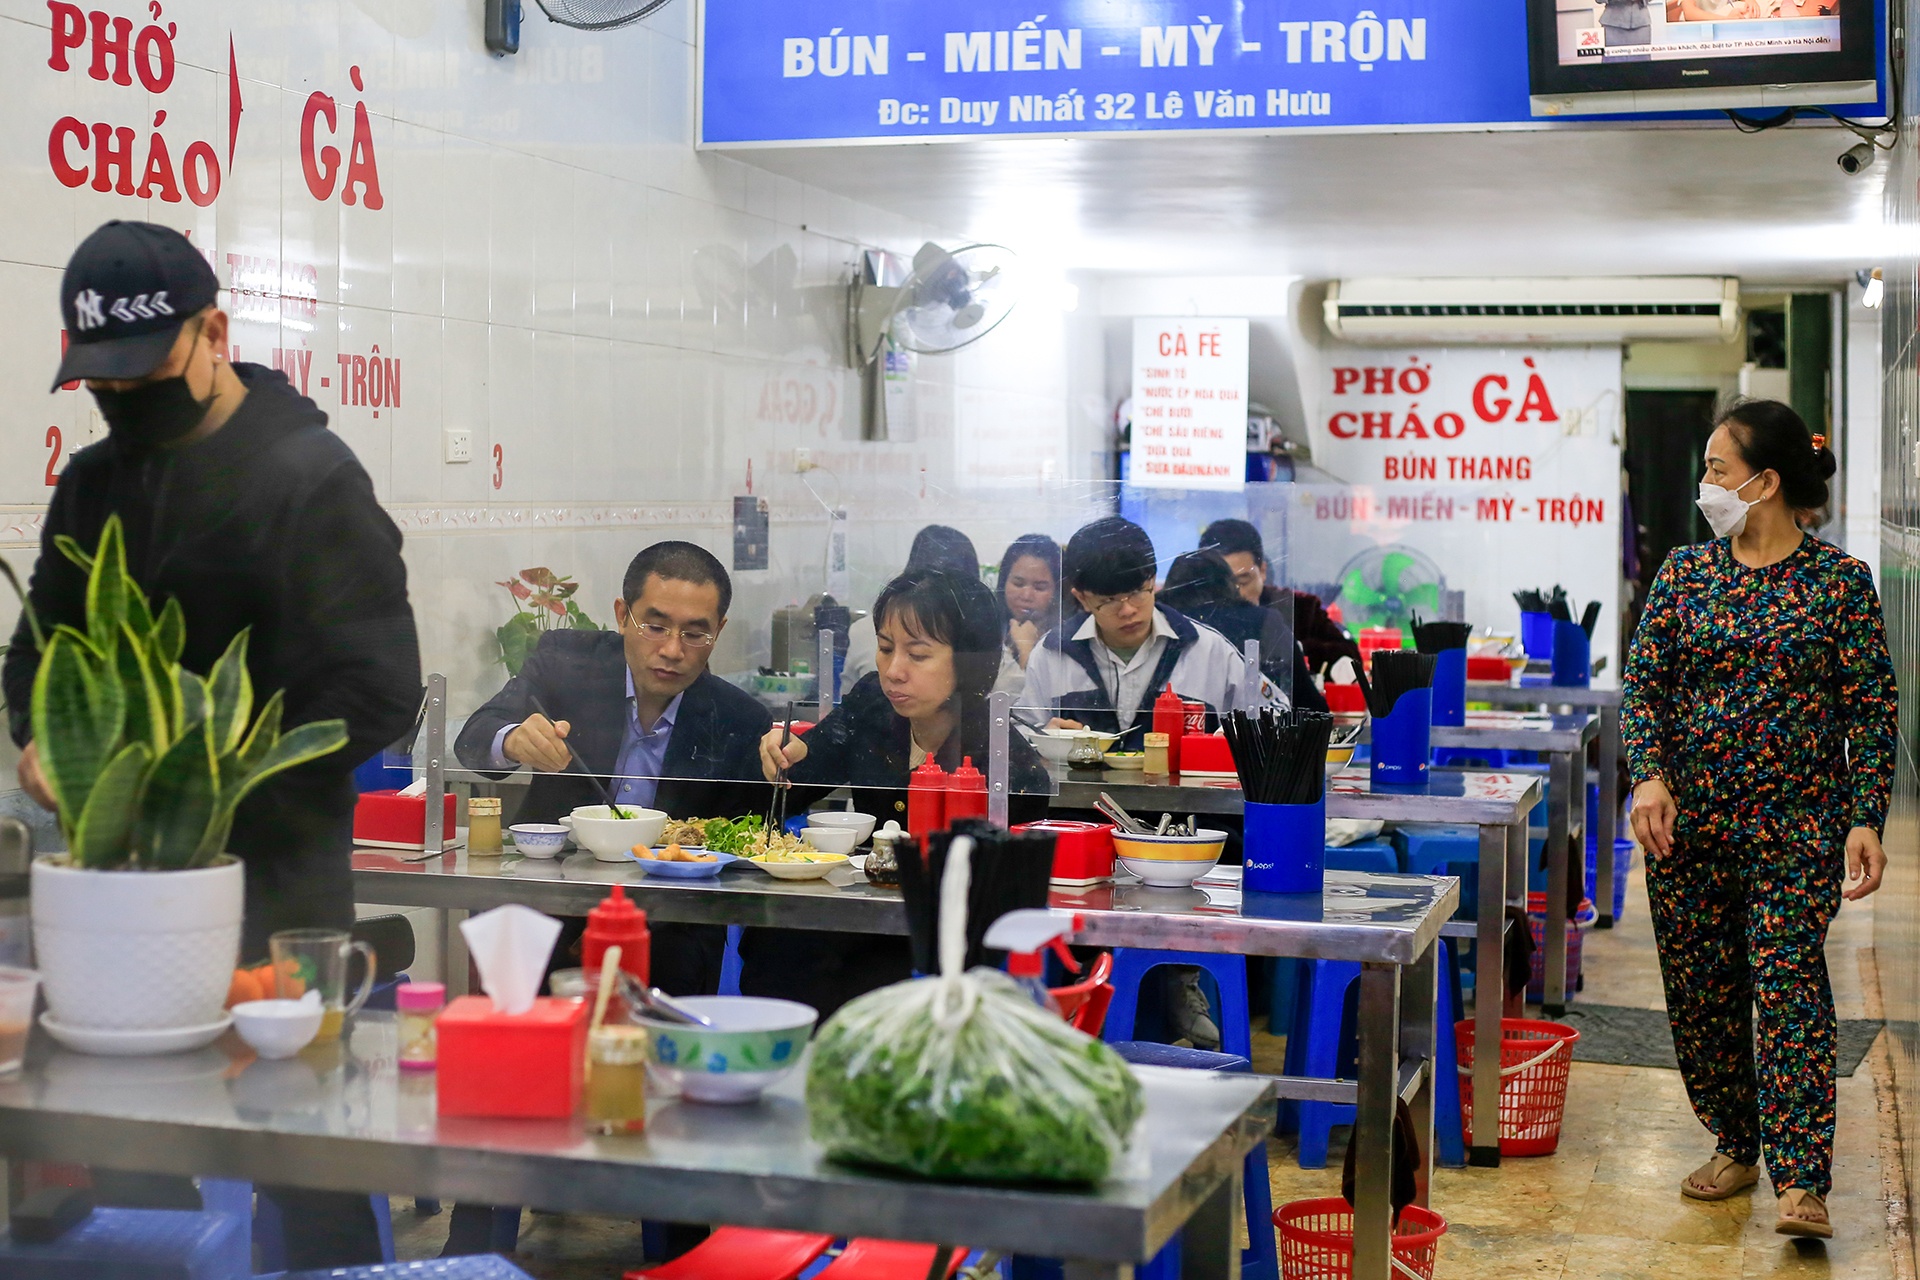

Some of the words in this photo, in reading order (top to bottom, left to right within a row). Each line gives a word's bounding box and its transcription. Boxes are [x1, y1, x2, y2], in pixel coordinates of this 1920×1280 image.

[47, 0, 177, 94] PHỞ
[783, 27, 889, 78] BÚN
[945, 14, 1082, 73] MIẾN
[1141, 15, 1222, 68] MỲ
[1279, 11, 1427, 71] TRỘN
[1793, 37, 1802, 45] Hà
[1803, 37, 1815, 46] Nội
[879, 99, 929, 125] Đc:
[940, 97, 999, 126] Duy
[1008, 88, 1085, 122] Nhất
[1095, 93, 1135, 120] 32
[1146, 91, 1183, 119] Lê
[1195, 89, 1254, 118] Văn
[48, 110, 221, 207] CHÁO
[300, 65, 384, 210] GÀ
[1158, 325, 1188, 357] CÀ
[338, 344, 400, 419] TRỘN
[1332, 356, 1432, 395] PHỞ
[1471, 356, 1560, 423] GÀ
[1327, 403, 1466, 440] CHÁO
[45, 426, 62, 486] 2
[493, 443, 503, 489] 3
[1384, 450, 1438, 481] BÚN
[1446, 455, 1532, 481] THANG
[1315, 493, 1369, 521] BÚN
[1387, 493, 1453, 521] MIẾN
[1476, 494, 1514, 522] MỲ
[1536, 494, 1604, 527] TRỘN
